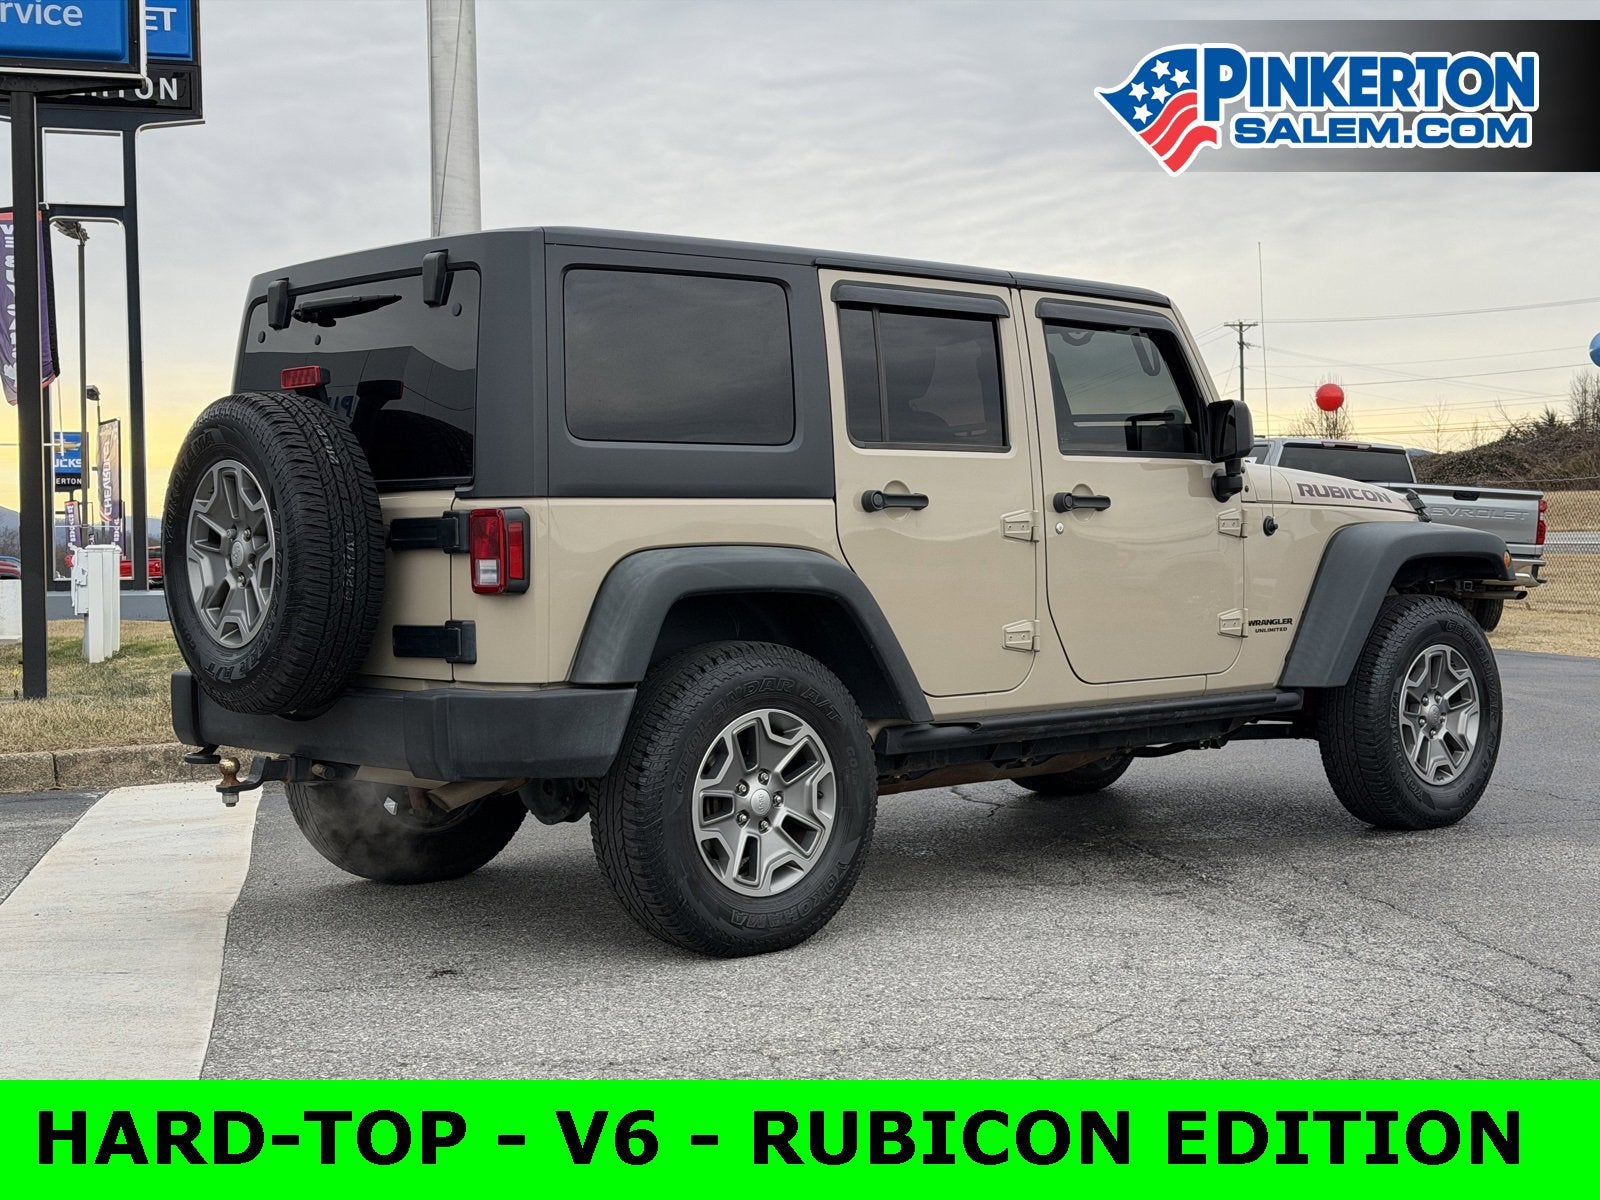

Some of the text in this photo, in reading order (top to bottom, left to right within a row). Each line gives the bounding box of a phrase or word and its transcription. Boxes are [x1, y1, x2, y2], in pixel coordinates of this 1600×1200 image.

[1296, 482, 1392, 504] RUBICON
[1248, 618, 1293, 627] WRANGLER
[800, 686, 842, 723] A/T
[731, 861, 850, 930] YOKOHAMA
